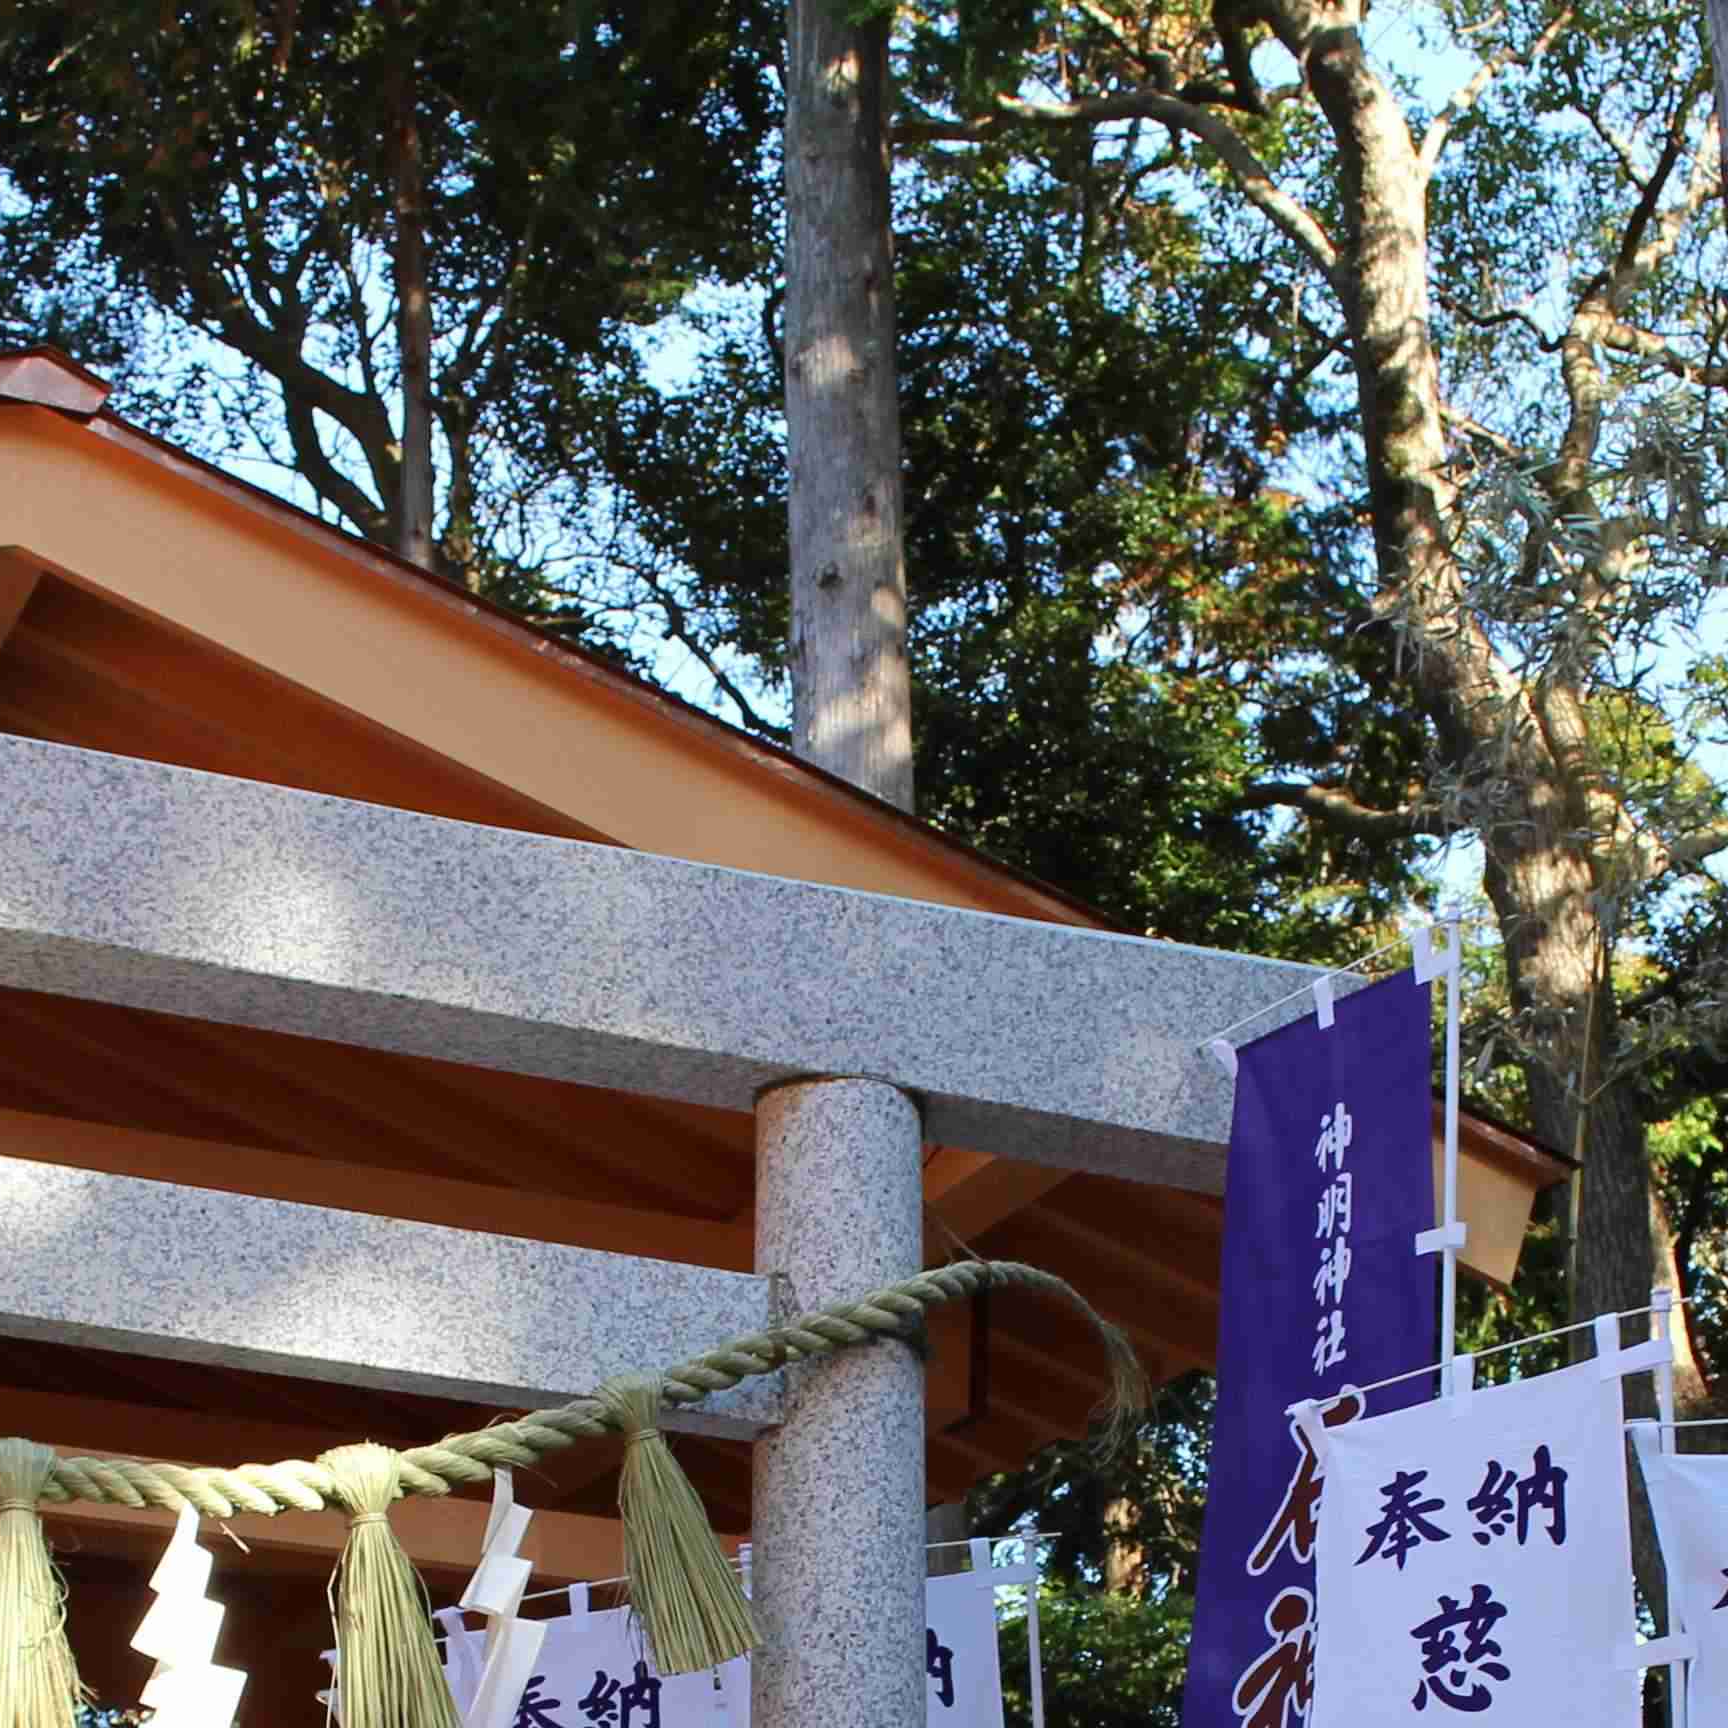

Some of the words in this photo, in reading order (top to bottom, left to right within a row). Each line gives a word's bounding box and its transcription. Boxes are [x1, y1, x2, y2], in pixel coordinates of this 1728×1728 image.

[1311, 1101, 1354, 1376] 神明神社
[1354, 1444, 1569, 1571] 奉納
